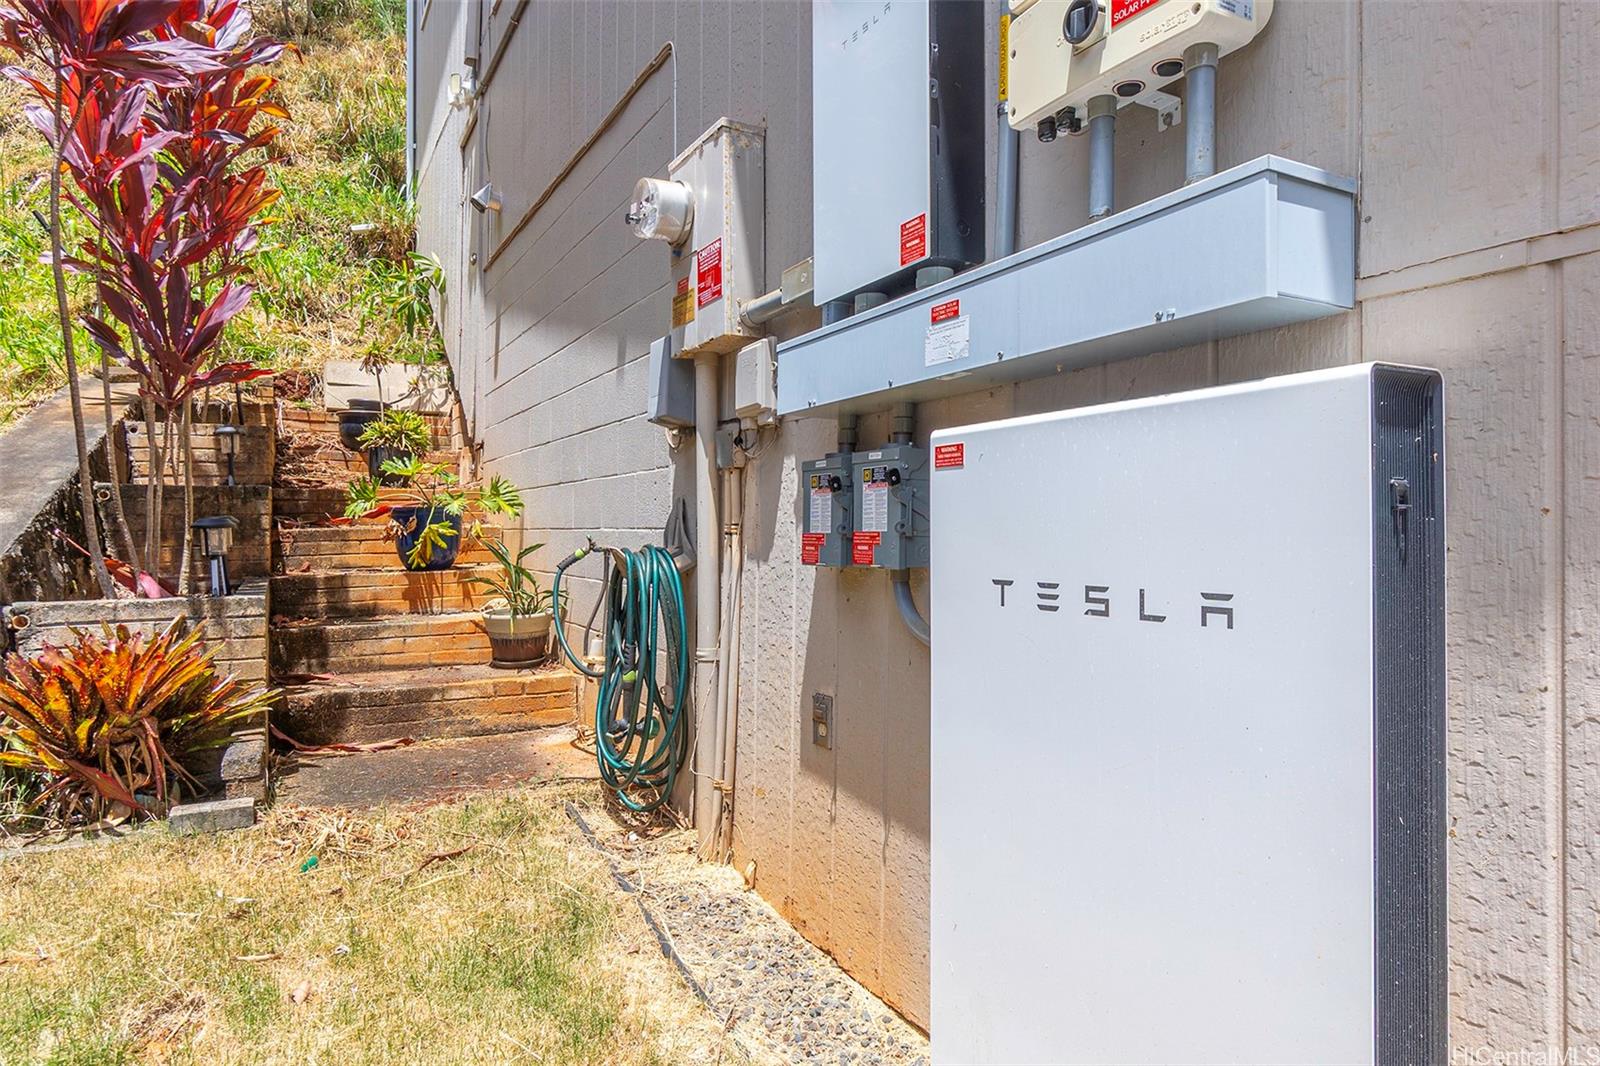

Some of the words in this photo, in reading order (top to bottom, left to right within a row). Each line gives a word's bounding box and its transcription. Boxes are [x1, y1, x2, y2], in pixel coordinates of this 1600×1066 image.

[841, 1, 891, 50] TESLA
[1113, 1, 1140, 22] SOLAR
[991, 579, 1234, 630] TESLA
